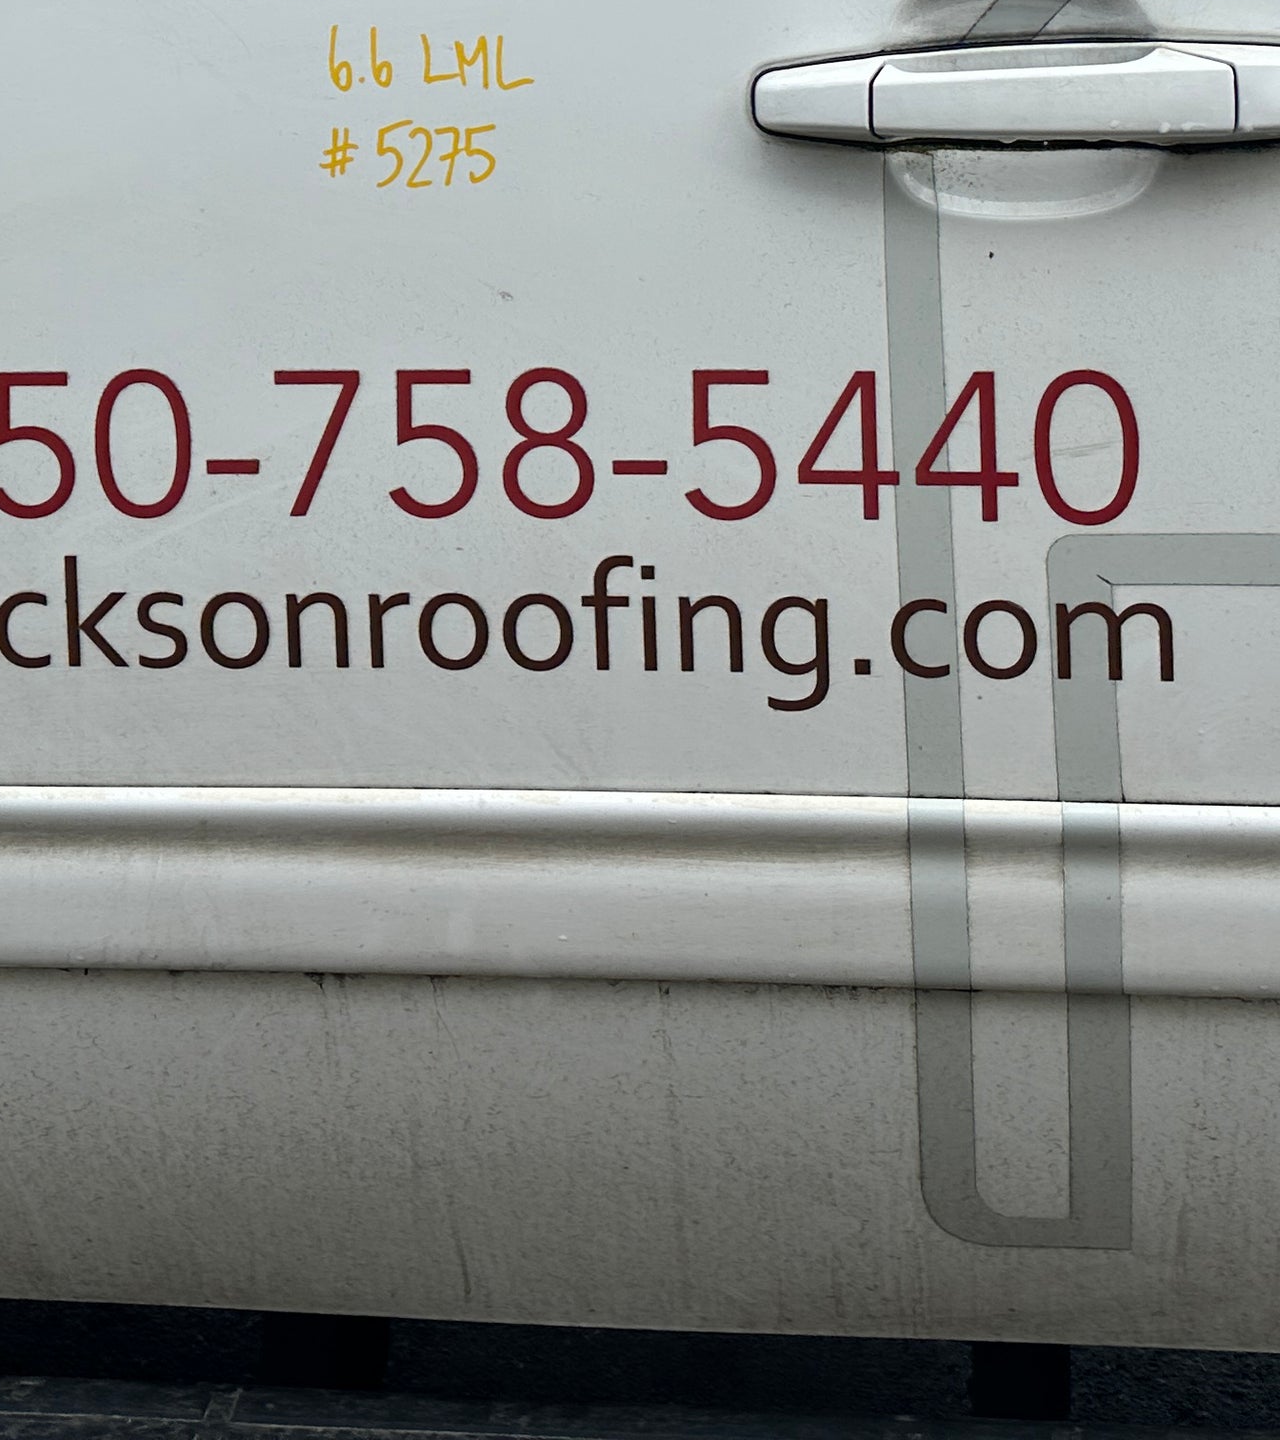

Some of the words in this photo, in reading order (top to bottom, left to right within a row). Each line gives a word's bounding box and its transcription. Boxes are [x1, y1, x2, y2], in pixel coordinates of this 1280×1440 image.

[328, 25, 393, 92] 6.6
[420, 34, 535, 91] LML
[376, 118, 497, 188] 5275
